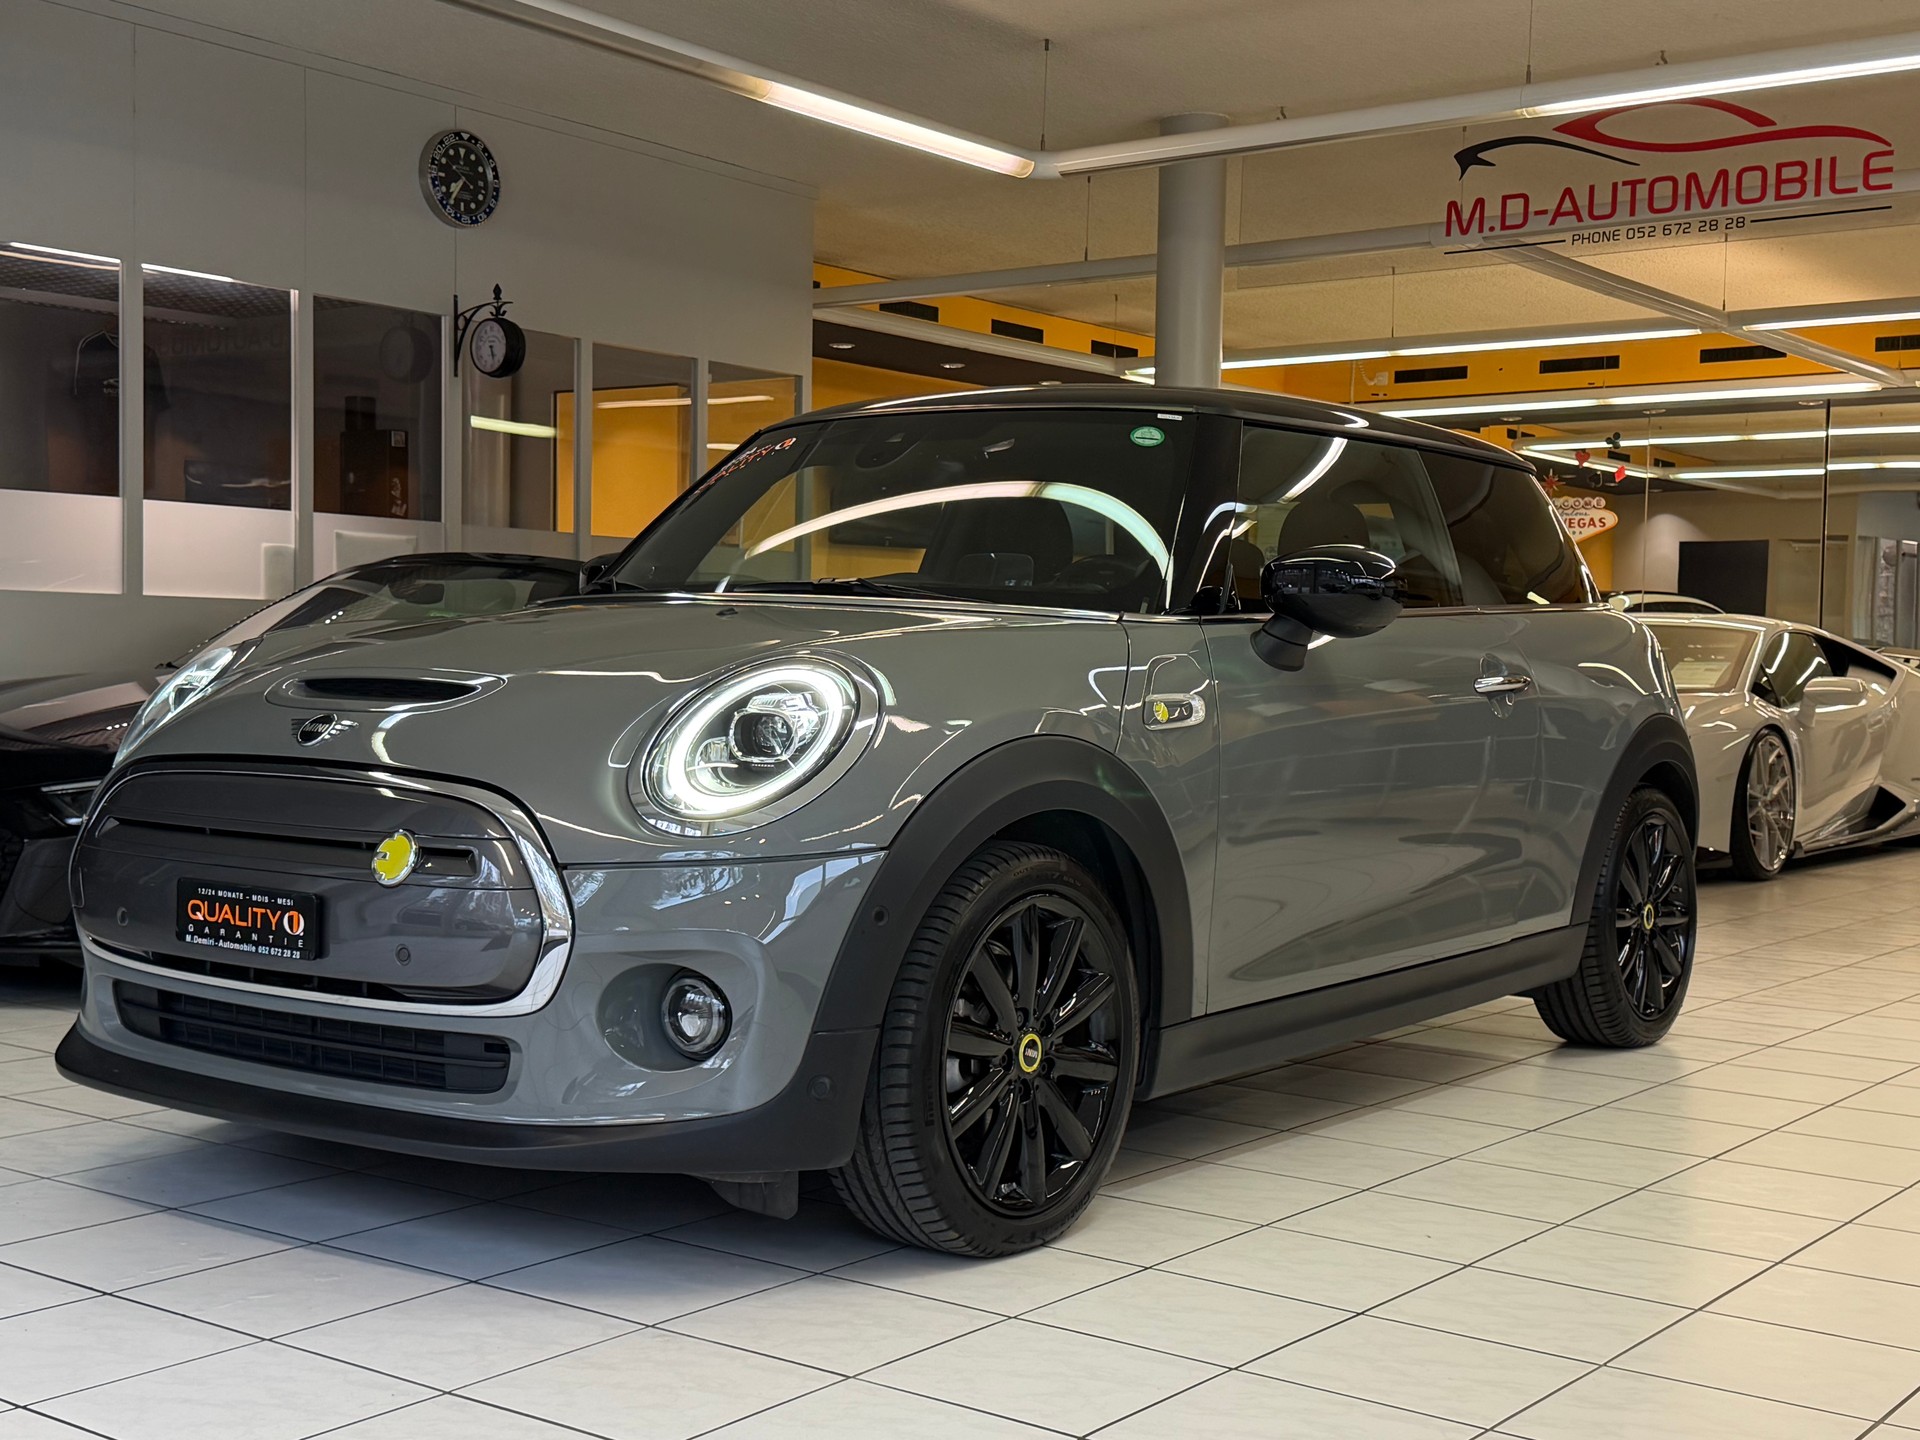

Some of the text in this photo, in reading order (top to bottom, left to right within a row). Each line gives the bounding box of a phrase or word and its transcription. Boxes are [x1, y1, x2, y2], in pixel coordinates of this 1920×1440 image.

[443, 133, 456, 145] 22
[433, 145, 443, 160] 20
[1444, 149, 1895, 237] M.D-AUTOMOBILE
[1571, 216, 1746, 246] PHONE 052 672 28 28
[303, 723, 329, 732] MINI
[198, 887, 216, 896] 12/24
[218, 890, 243, 900] MONATE
[252, 894, 268, 903] MOIS
[277, 897, 294, 906] MESI
[188, 899, 281, 930] QUALITY
[188, 924, 303, 947] GARANTIE
[258, 946, 269, 955] 052
[270, 948, 282, 957] 672
[283, 949, 291, 958] 28
[292, 951, 301, 959] 28
